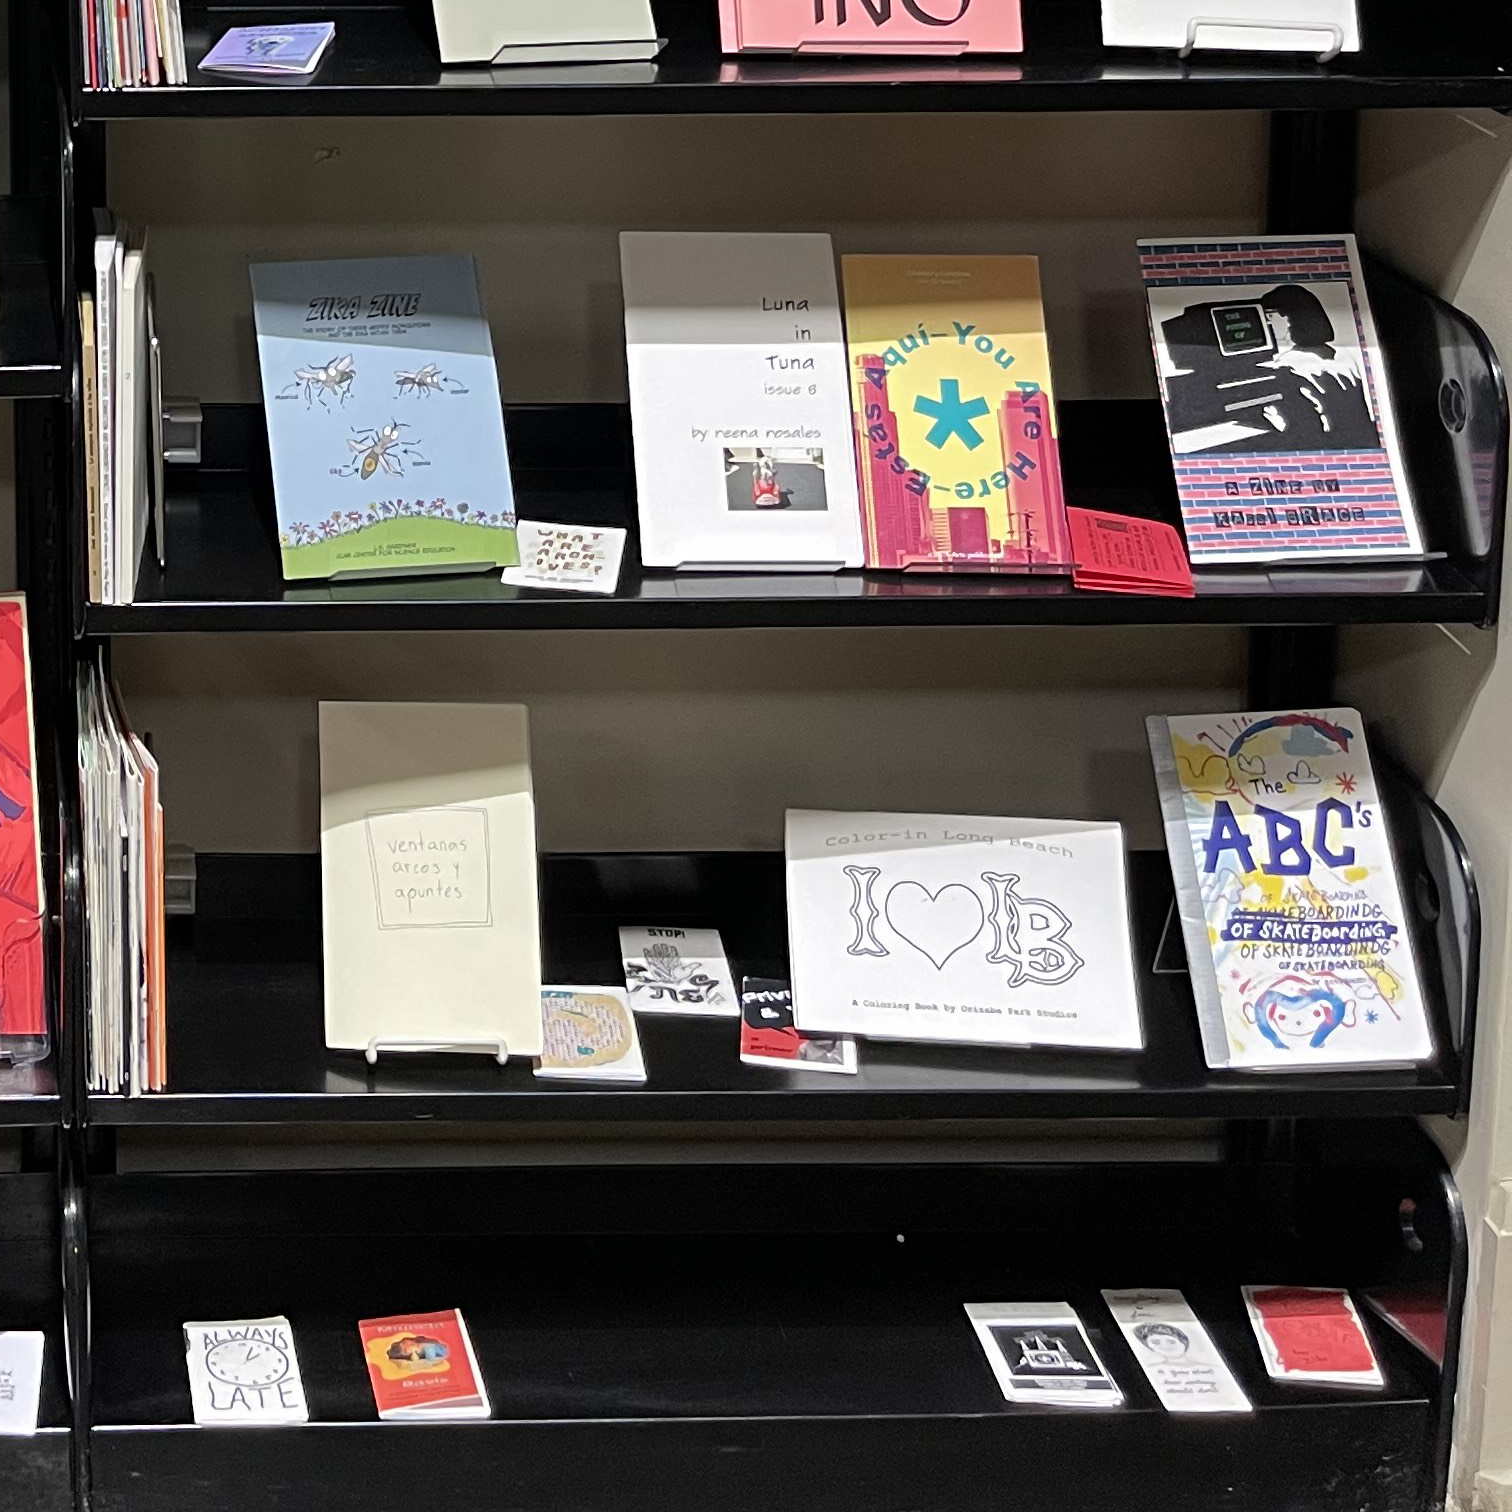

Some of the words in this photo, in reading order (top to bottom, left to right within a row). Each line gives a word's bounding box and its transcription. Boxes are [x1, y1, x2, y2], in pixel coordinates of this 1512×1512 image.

[306, 296, 361, 321] ZIKA
[367, 293, 421, 318] ZINE
[761, 296, 809, 312] Luna
[794, 324, 811, 340] in
[764, 355, 814, 371] Tuna
[763, 382, 801, 396] issue
[691, 426, 708, 441] by
[715, 428, 758, 439] reena
[765, 426, 821, 439] rosales
[1225, 482, 1239, 496] A
[1248, 477, 1303, 495] ZINE
[1249, 778, 1287, 795] The
[388, 831, 467, 853] ventanas
[825, 829, 928, 847] Color-in
[942, 829, 994, 846] Long
[1009, 837, 1074, 859] Beach
[1202, 797, 1373, 876] ABC's
[392, 860, 441, 875] arcos
[453, 861, 460, 878] y
[395, 880, 463, 913] apuntes
[842, 865, 890, 957] I
[647, 928, 686, 938] STOP!
[1231, 923, 1253, 938] OF
[863, 1000, 909, 1010] Coloring
[944, 1004, 956, 1013] by
[203, 1327, 289, 1351] ALWAYS
[208, 1377, 299, 1411] LATE
